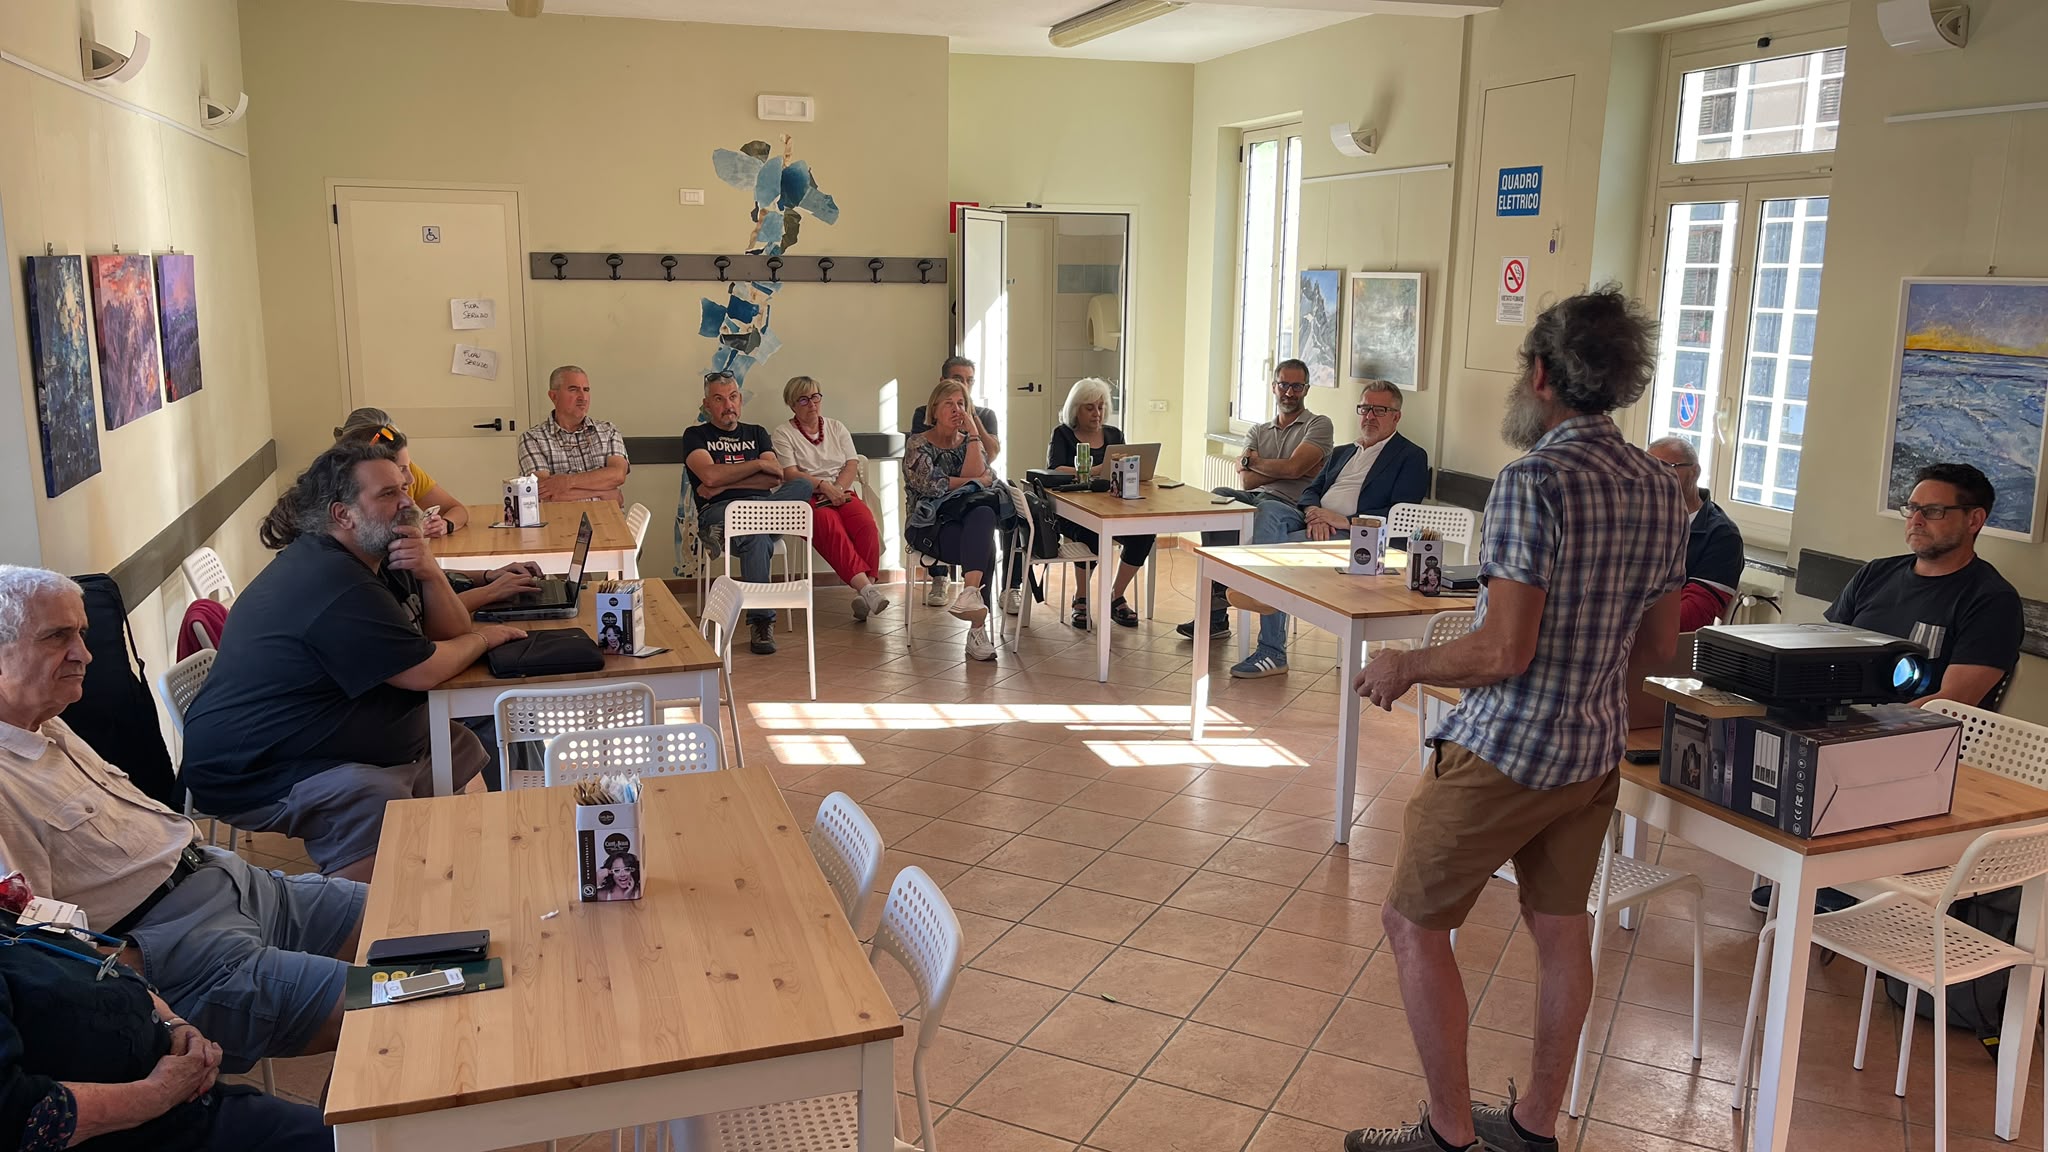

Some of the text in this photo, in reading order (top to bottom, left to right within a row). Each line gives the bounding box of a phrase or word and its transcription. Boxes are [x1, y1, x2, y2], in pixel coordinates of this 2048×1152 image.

[1502, 172, 1539, 190] QUADRO
[1498, 193, 1539, 210] ELETTRICO
[707, 440, 756, 452] NORWAY
